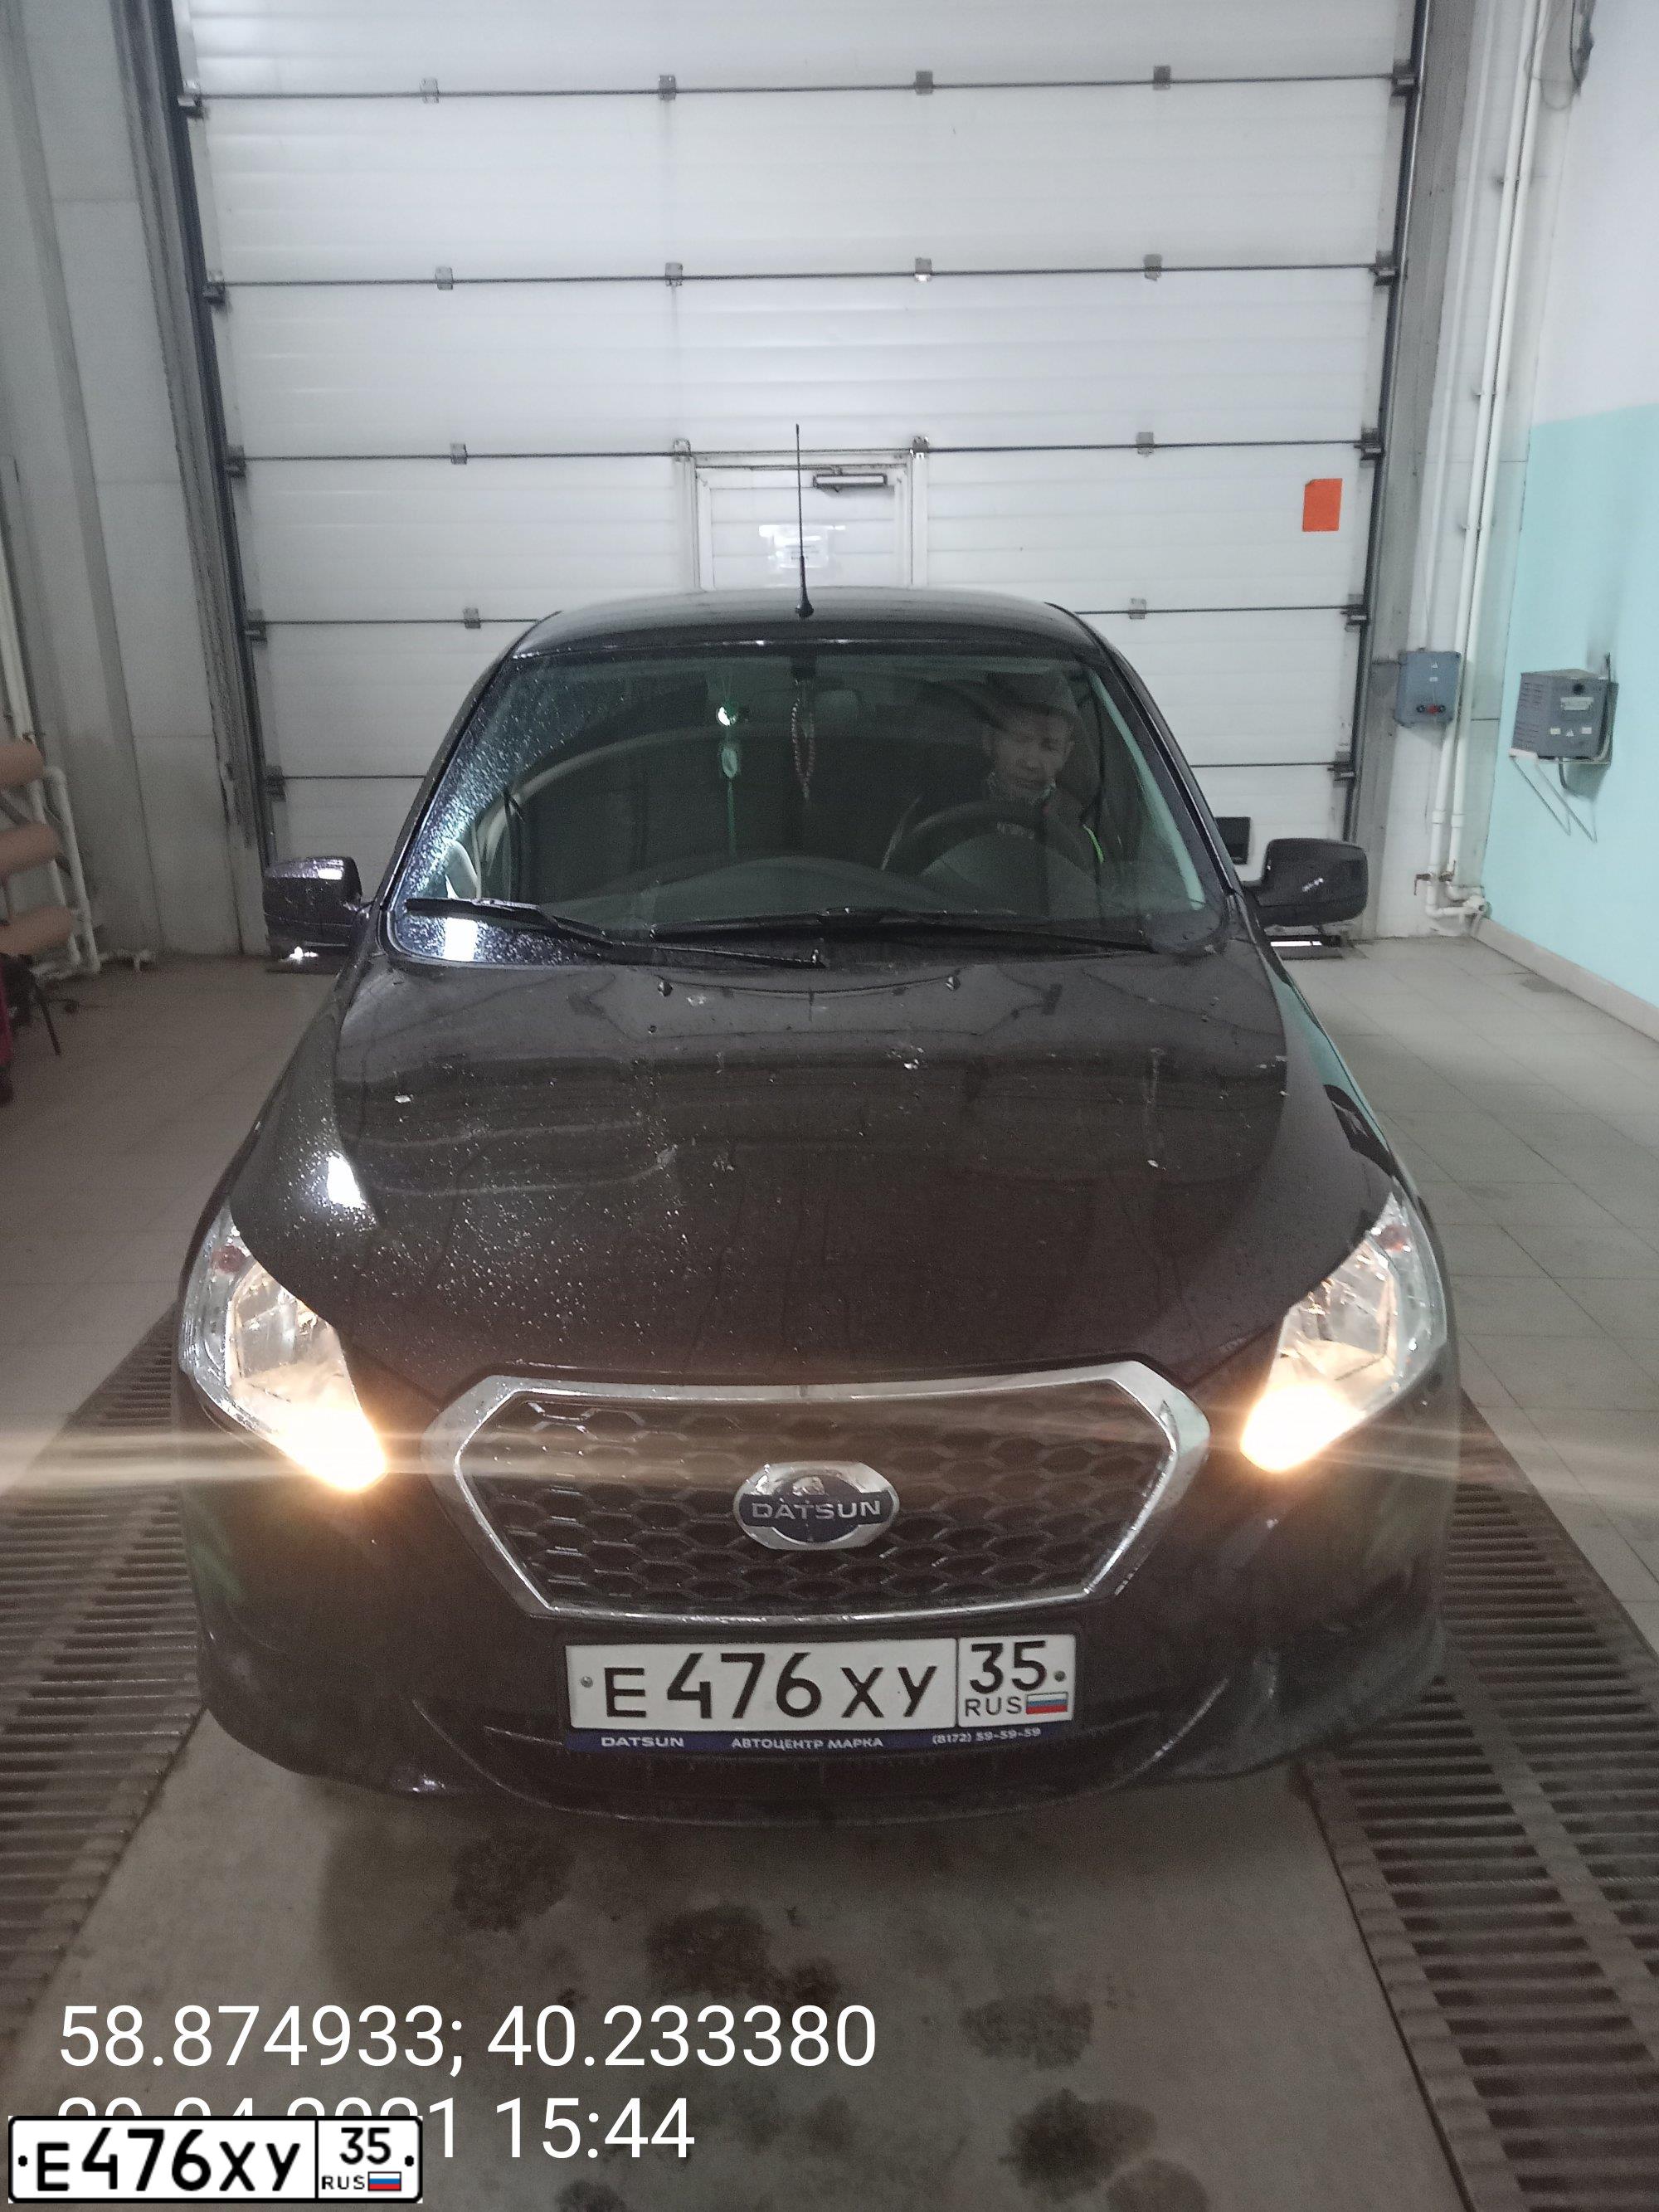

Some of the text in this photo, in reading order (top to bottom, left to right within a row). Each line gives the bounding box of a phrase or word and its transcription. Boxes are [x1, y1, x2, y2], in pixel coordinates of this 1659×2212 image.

[751, 1499, 882, 1520] DATSUN
[969, 1640, 1048, 1695] 35
[965, 1696, 1023, 1717] RUS
[601, 1737, 684, 1747] DATSUN
[731, 1737, 883, 1751] АВТОЦЕНТР МАРКА
[932, 1732, 972, 1745] (8172)
